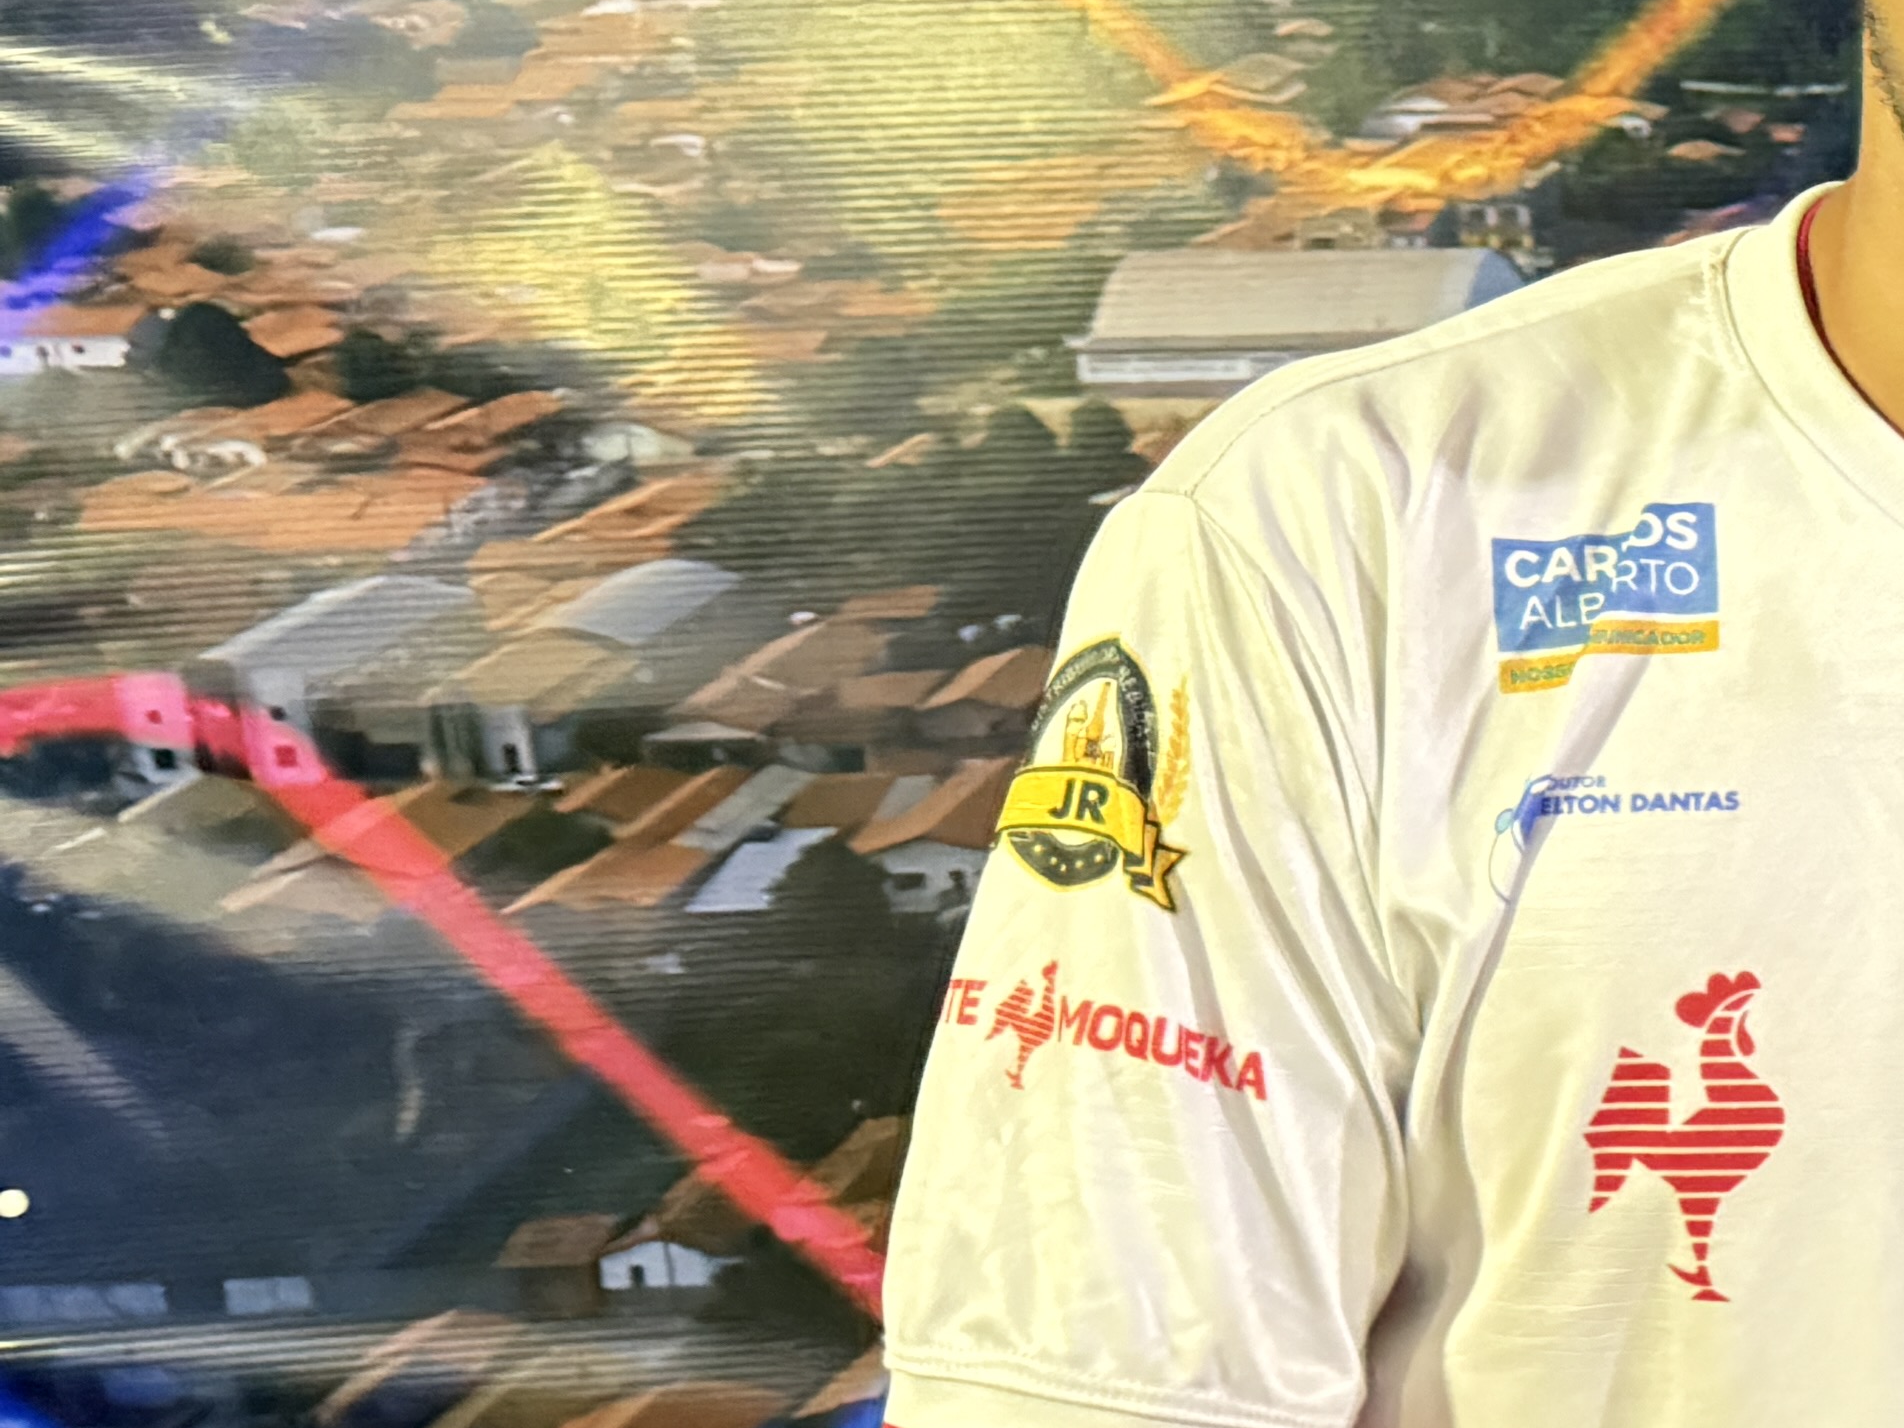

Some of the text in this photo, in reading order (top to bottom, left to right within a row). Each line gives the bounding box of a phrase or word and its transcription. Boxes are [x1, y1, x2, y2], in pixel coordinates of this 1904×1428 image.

[1047, 777, 1111, 826] JR
[1629, 790, 1741, 813] DANTAS
[1057, 994, 1268, 1102] MOQUEKA
